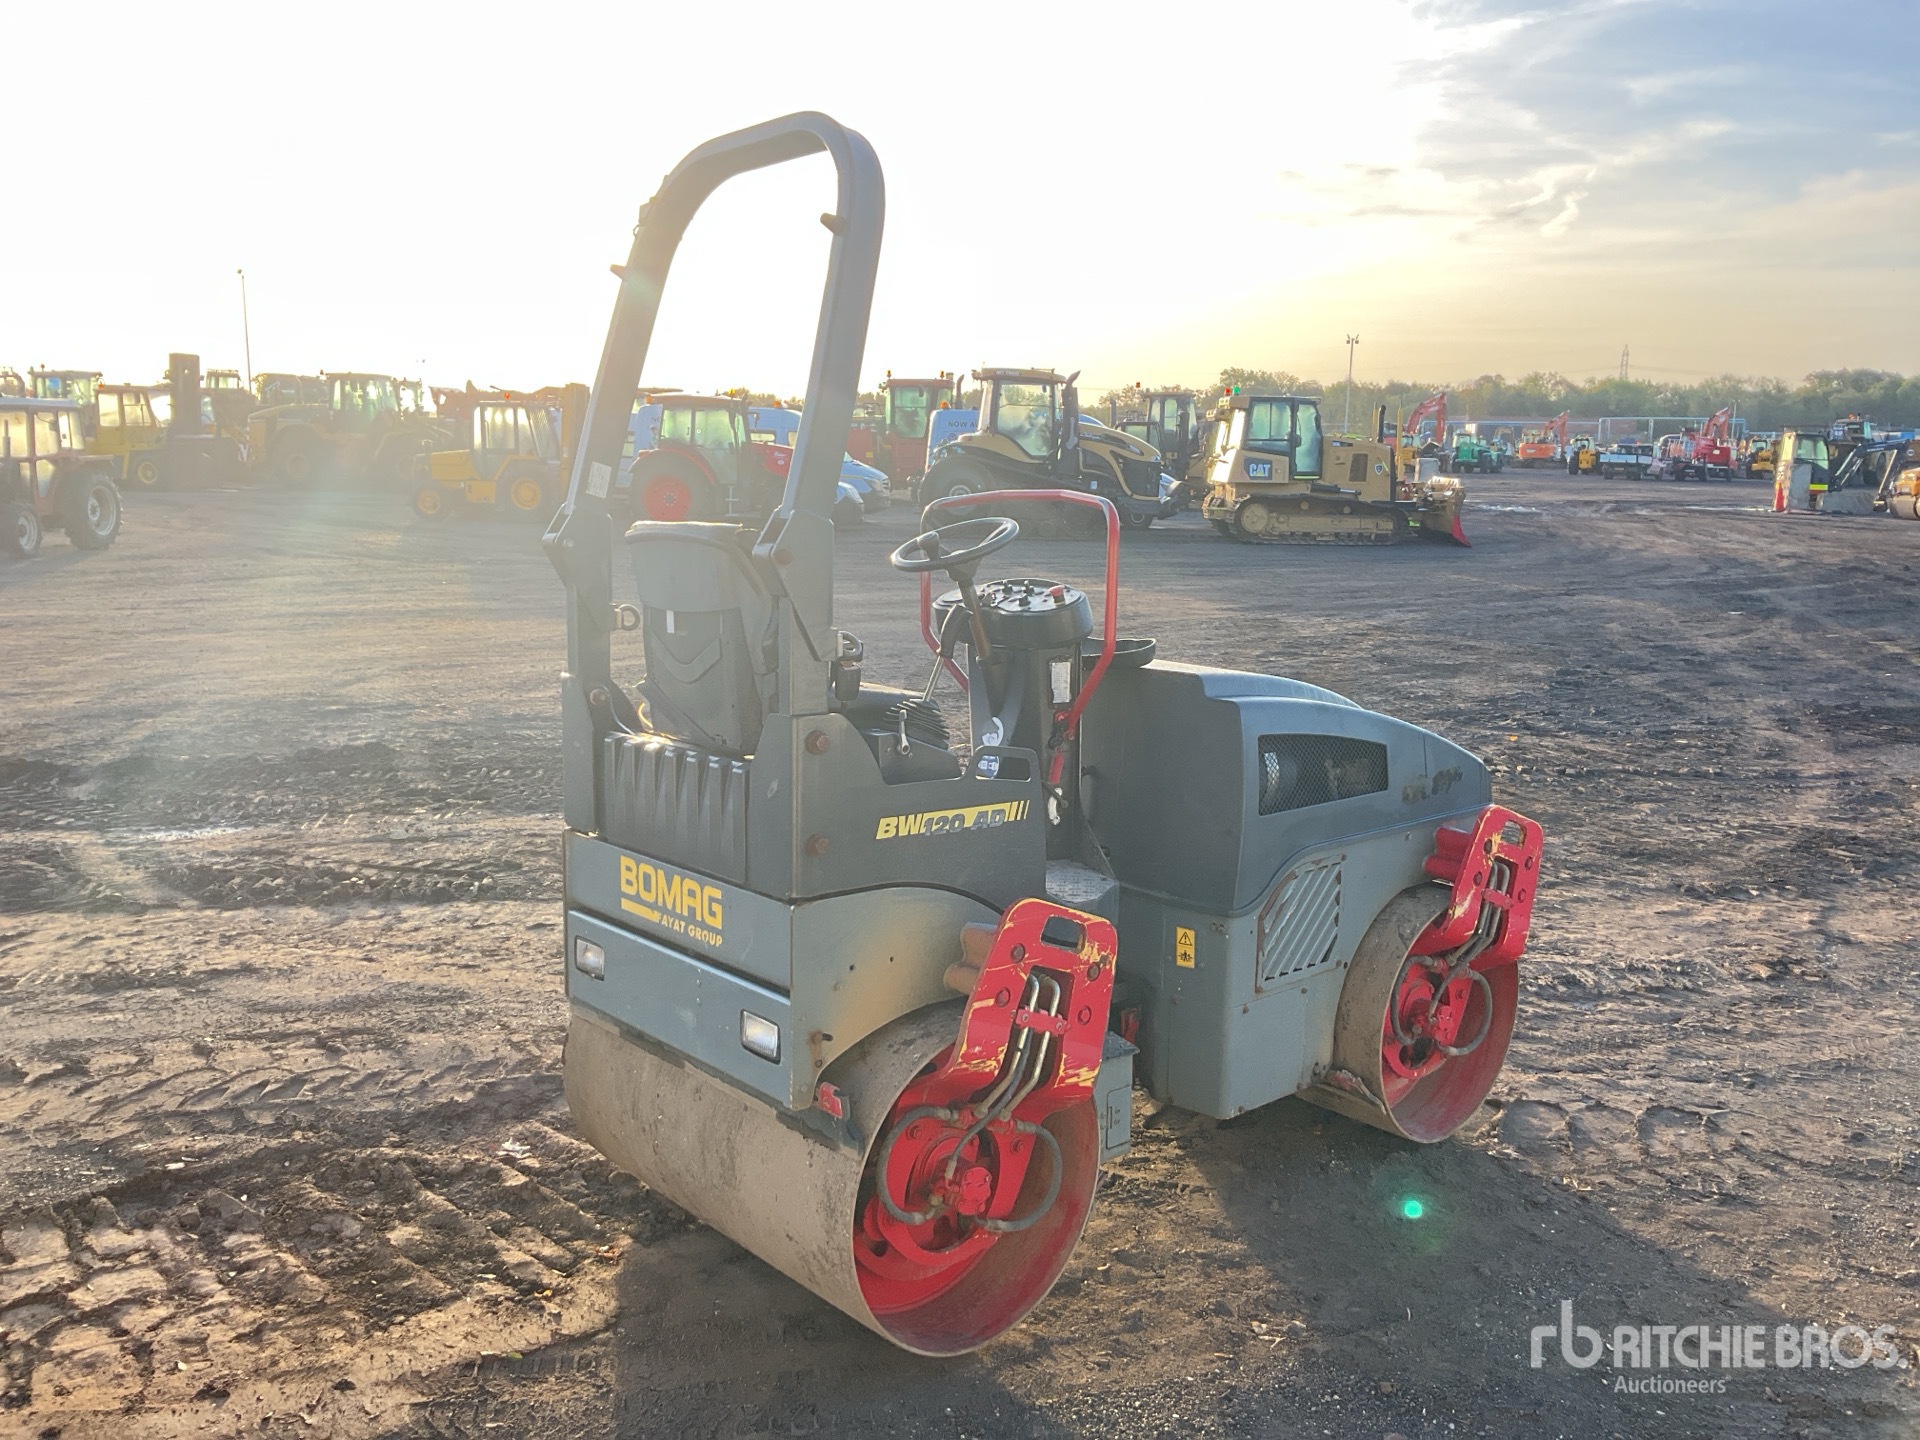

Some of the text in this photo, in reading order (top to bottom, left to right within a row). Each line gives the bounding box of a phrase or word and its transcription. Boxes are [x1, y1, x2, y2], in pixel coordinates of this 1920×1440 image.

[1249, 463, 1271, 477] CAT
[971, 808, 1007, 831] AD
[620, 855, 723, 930] BOMAG
[687, 924, 723, 948] GROUP
